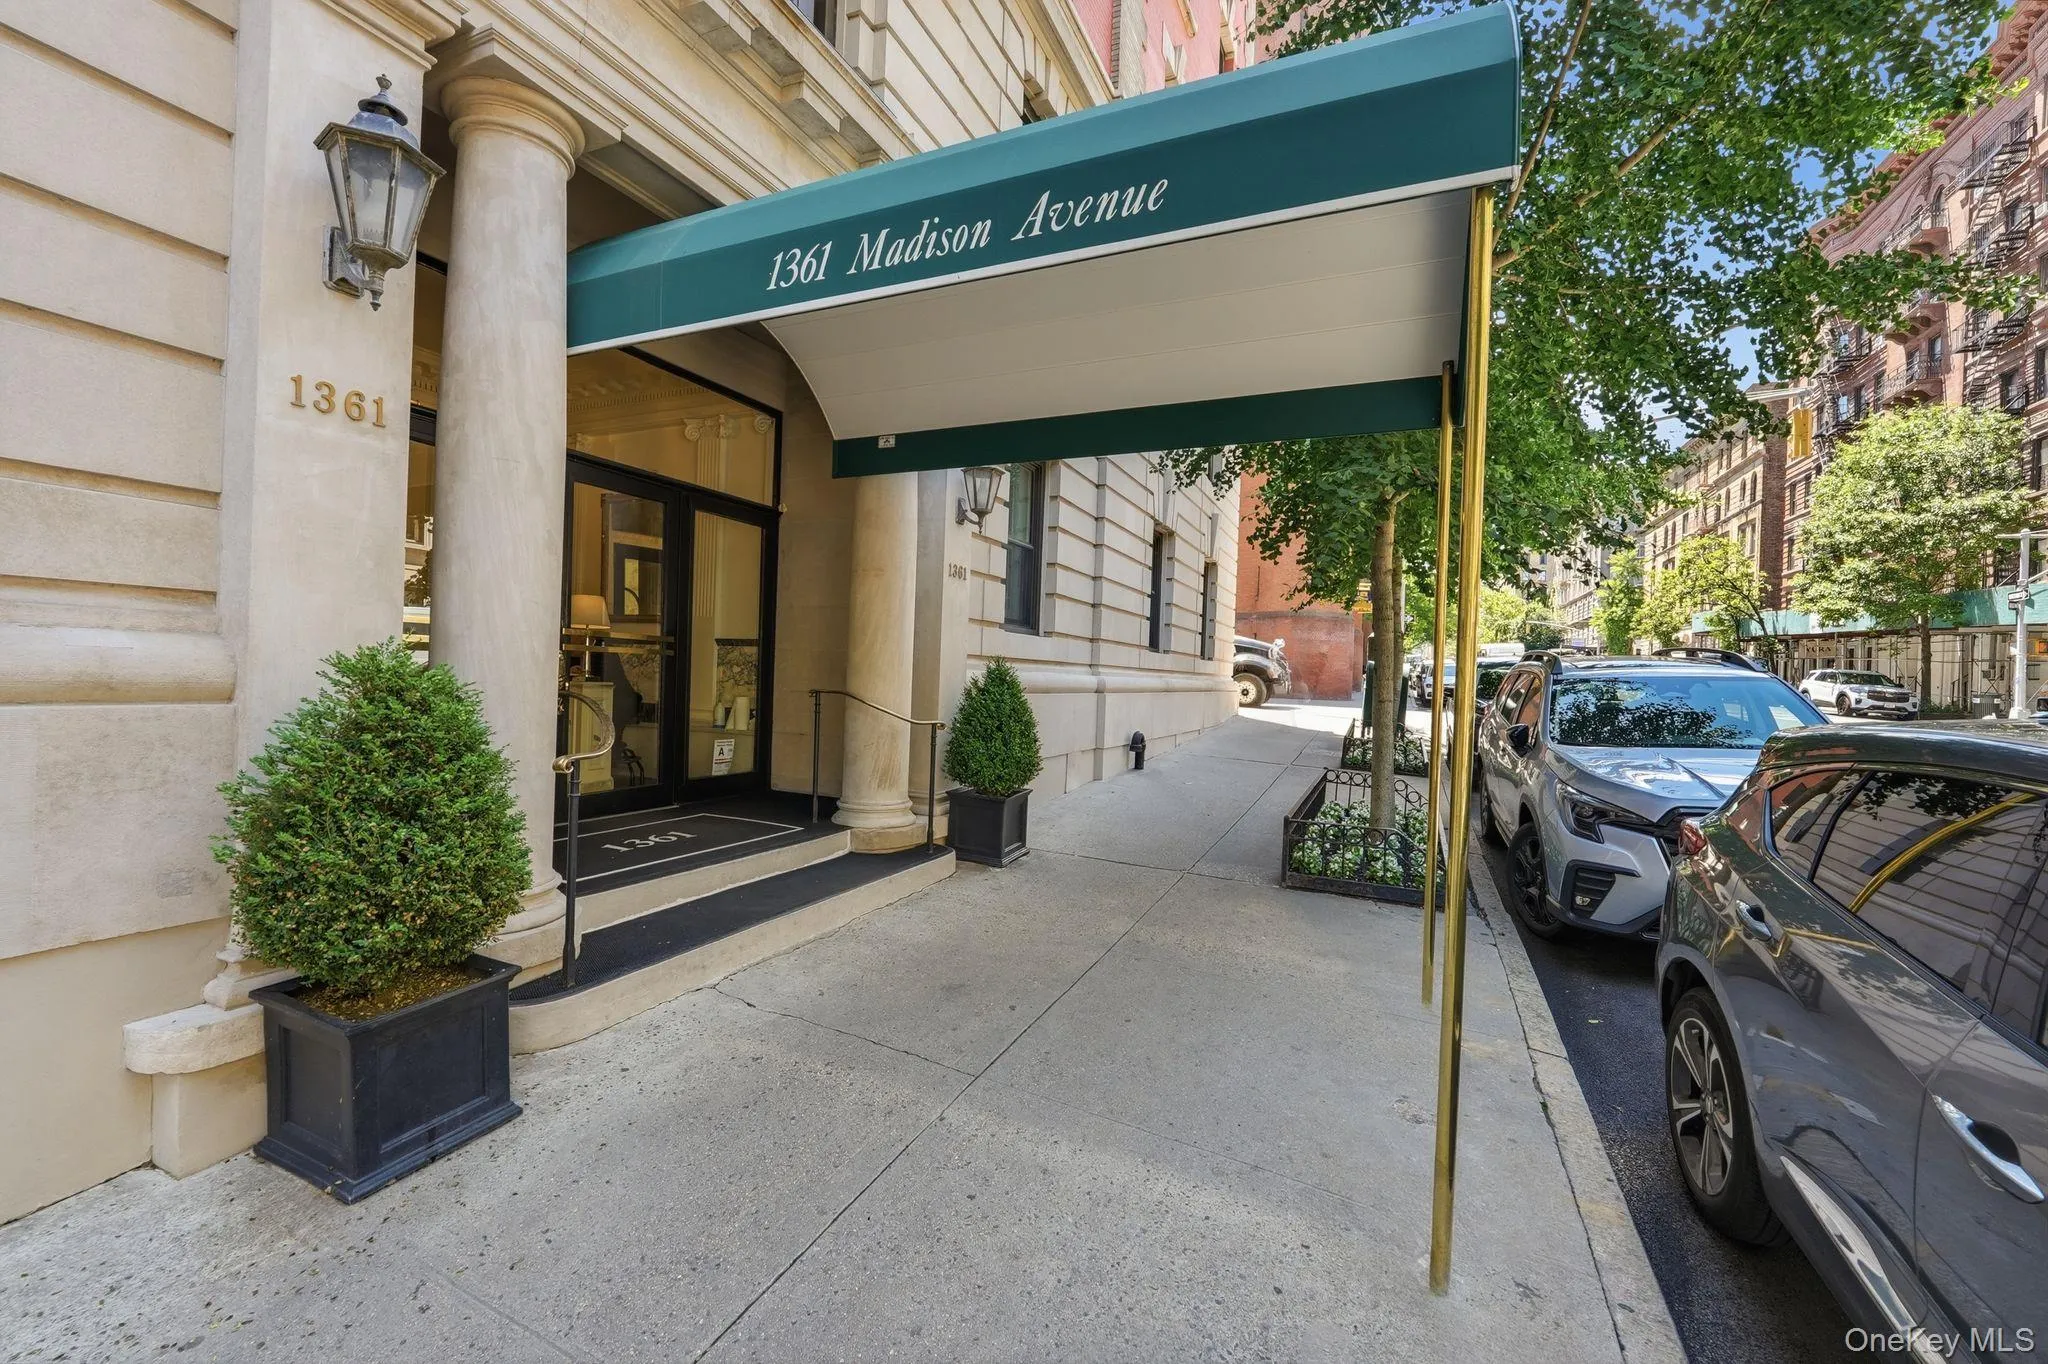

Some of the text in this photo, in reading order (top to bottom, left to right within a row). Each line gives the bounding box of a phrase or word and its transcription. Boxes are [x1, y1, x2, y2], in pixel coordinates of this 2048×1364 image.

[766, 178, 1169, 291] 1361 Madison Avenue
[290, 374, 386, 428] 1361
[948, 562, 967, 581] 1361
[718, 746, 725, 757] A
[601, 831, 698, 853] 1361
